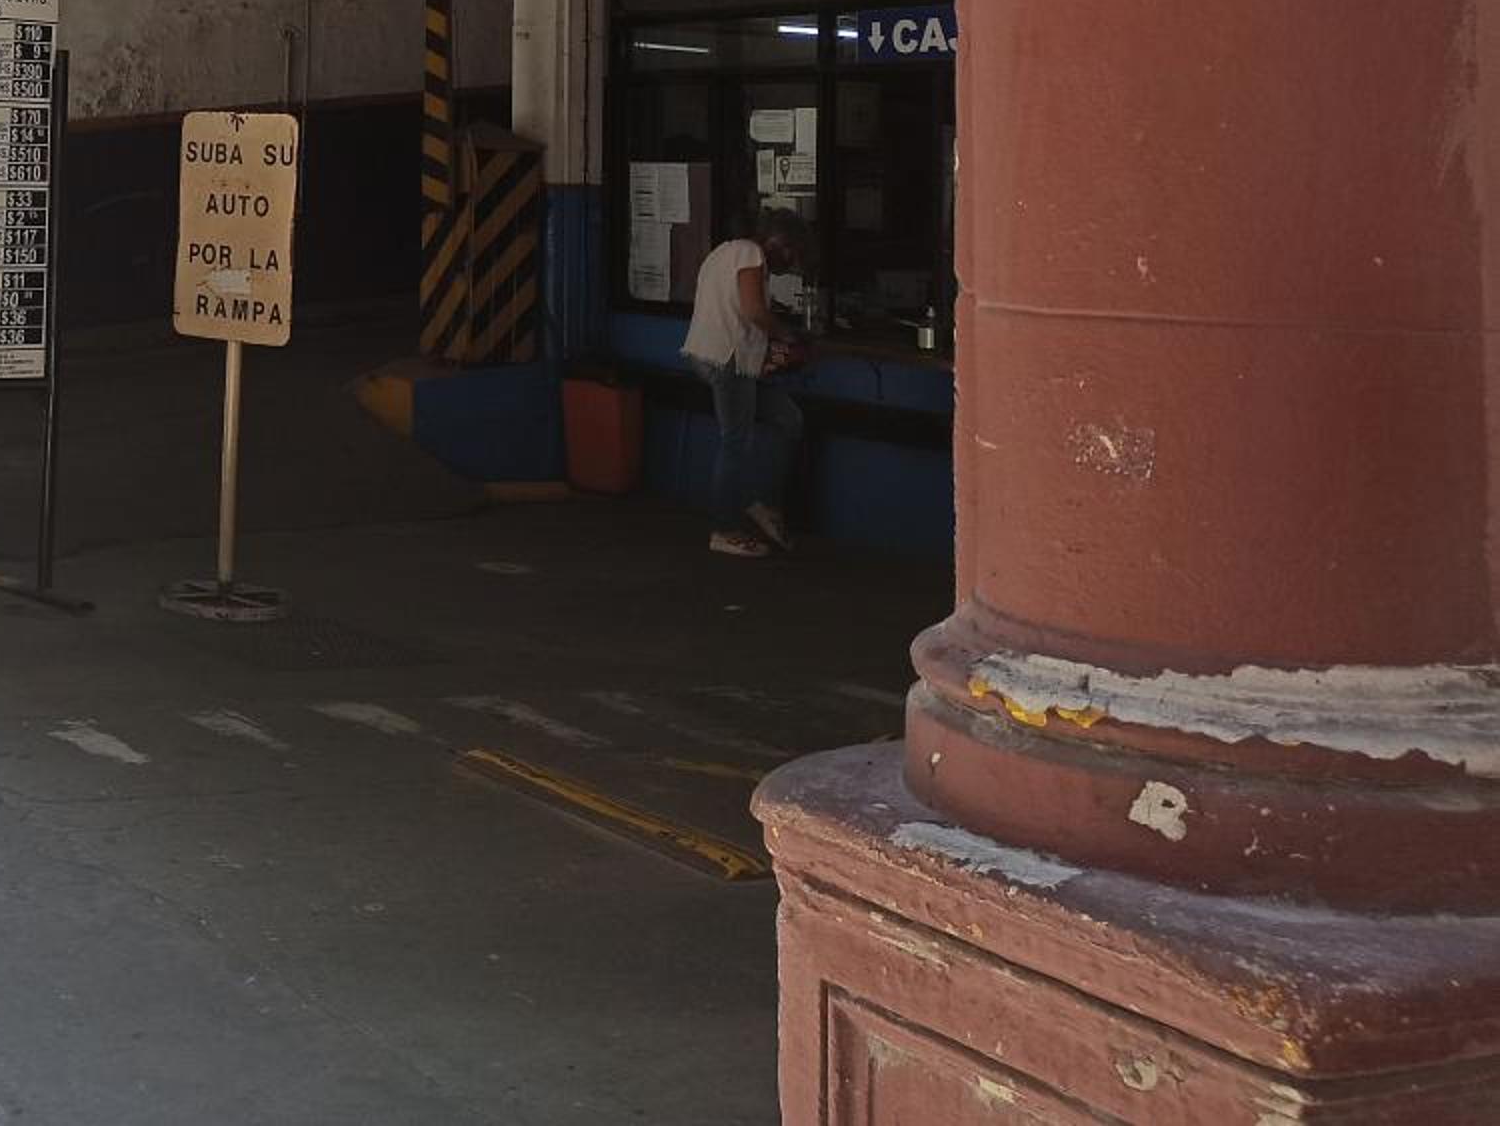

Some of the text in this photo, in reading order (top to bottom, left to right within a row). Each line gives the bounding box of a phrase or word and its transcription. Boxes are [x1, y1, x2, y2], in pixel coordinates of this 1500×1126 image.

[892, 17, 958, 54] CA
[14, 81, 43, 97] $500
[11, 147, 40, 162] $510
[185, 141, 294, 166] SUBA SU
[9, 165, 40, 180] $610
[7, 192, 33, 207] $33
[205, 194, 269, 217] AUTO
[5, 229, 37, 245] $117
[5, 249, 37, 263] $150
[189, 243, 279, 271] POR LA
[3, 273, 25, 288] $11
[1, 309, 27, 325] $36
[195, 294, 283, 324] RAMPA
[0, 329, 25, 344] $36
